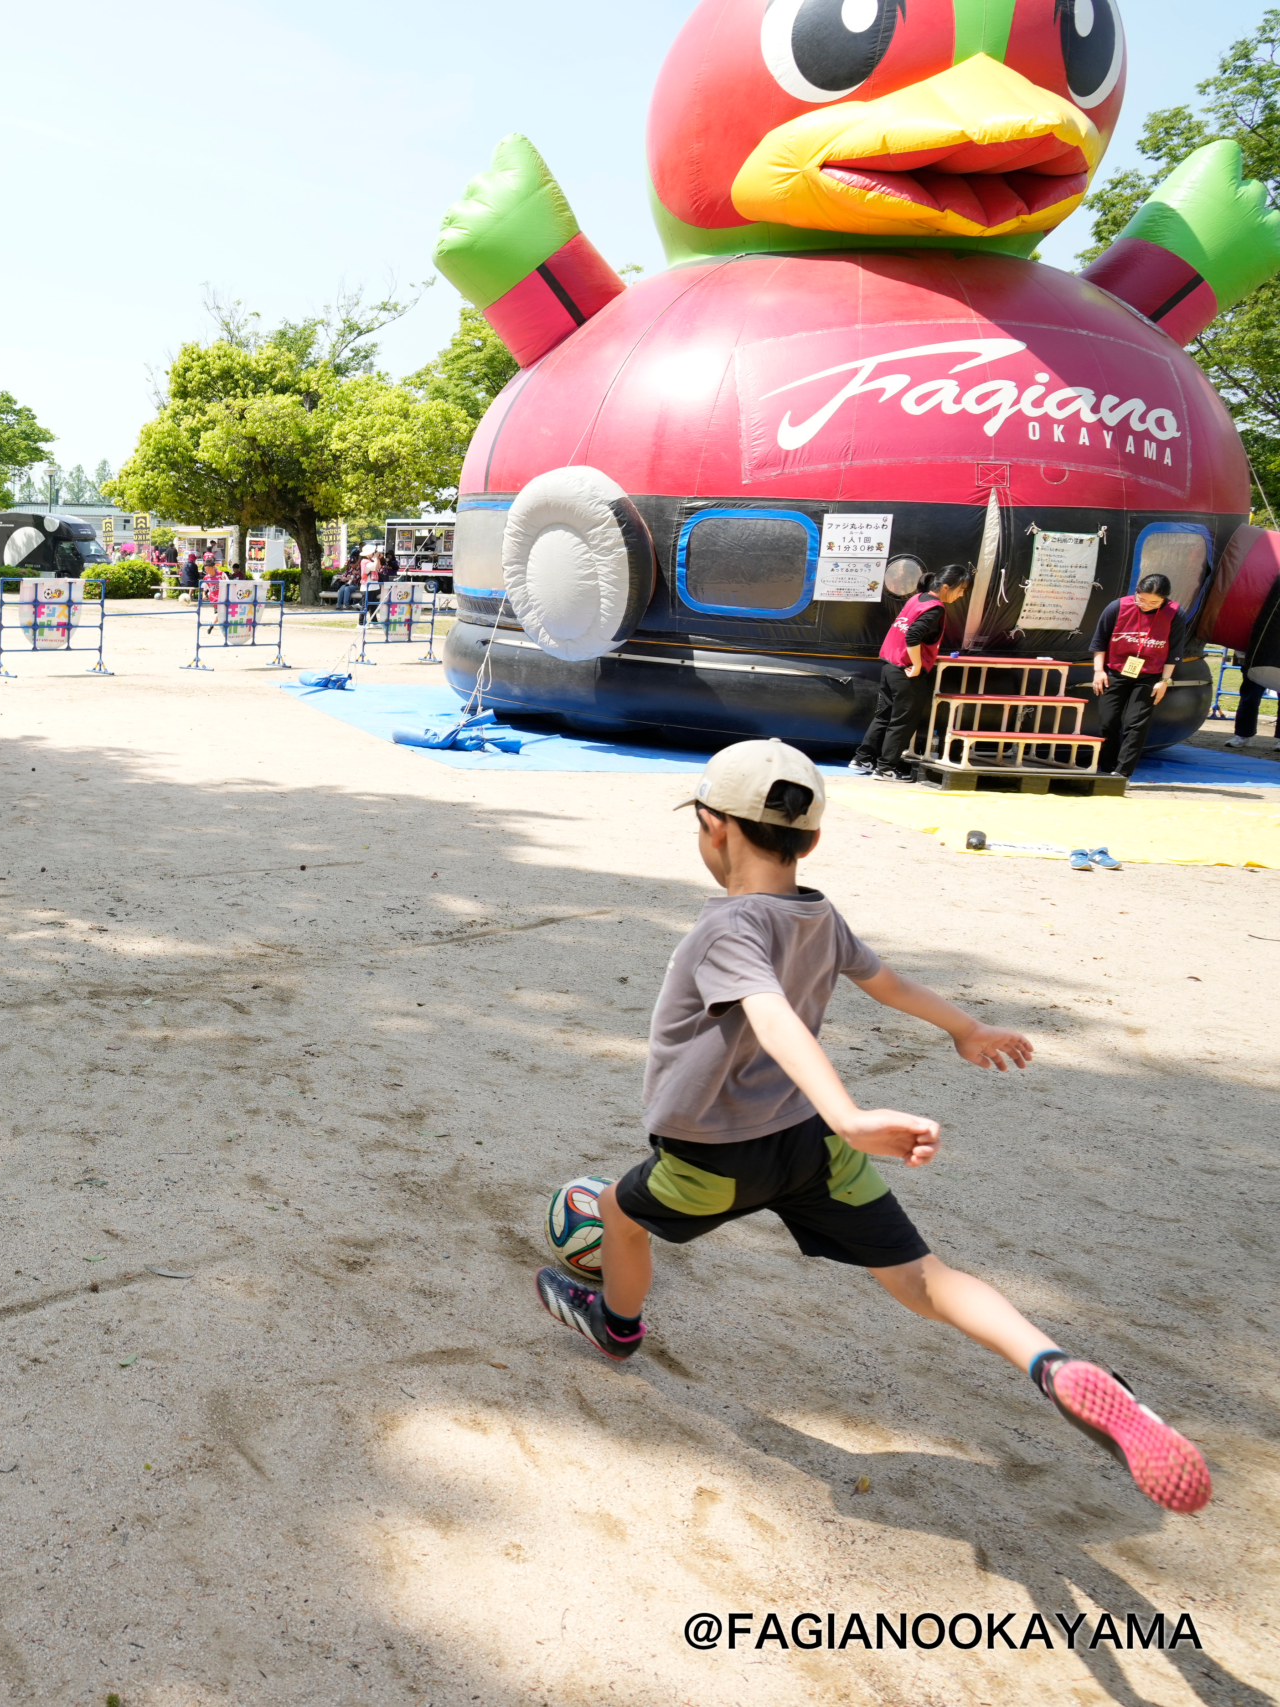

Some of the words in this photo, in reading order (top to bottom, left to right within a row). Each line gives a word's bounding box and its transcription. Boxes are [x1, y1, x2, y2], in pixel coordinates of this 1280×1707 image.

[759, 338, 1181, 450] Fagiano
[1028, 421, 1173, 467] OKAYAMA
[827, 522, 888, 530] ファジ丸ふわふわ
[837, 544, 874, 552] 1分30秒
